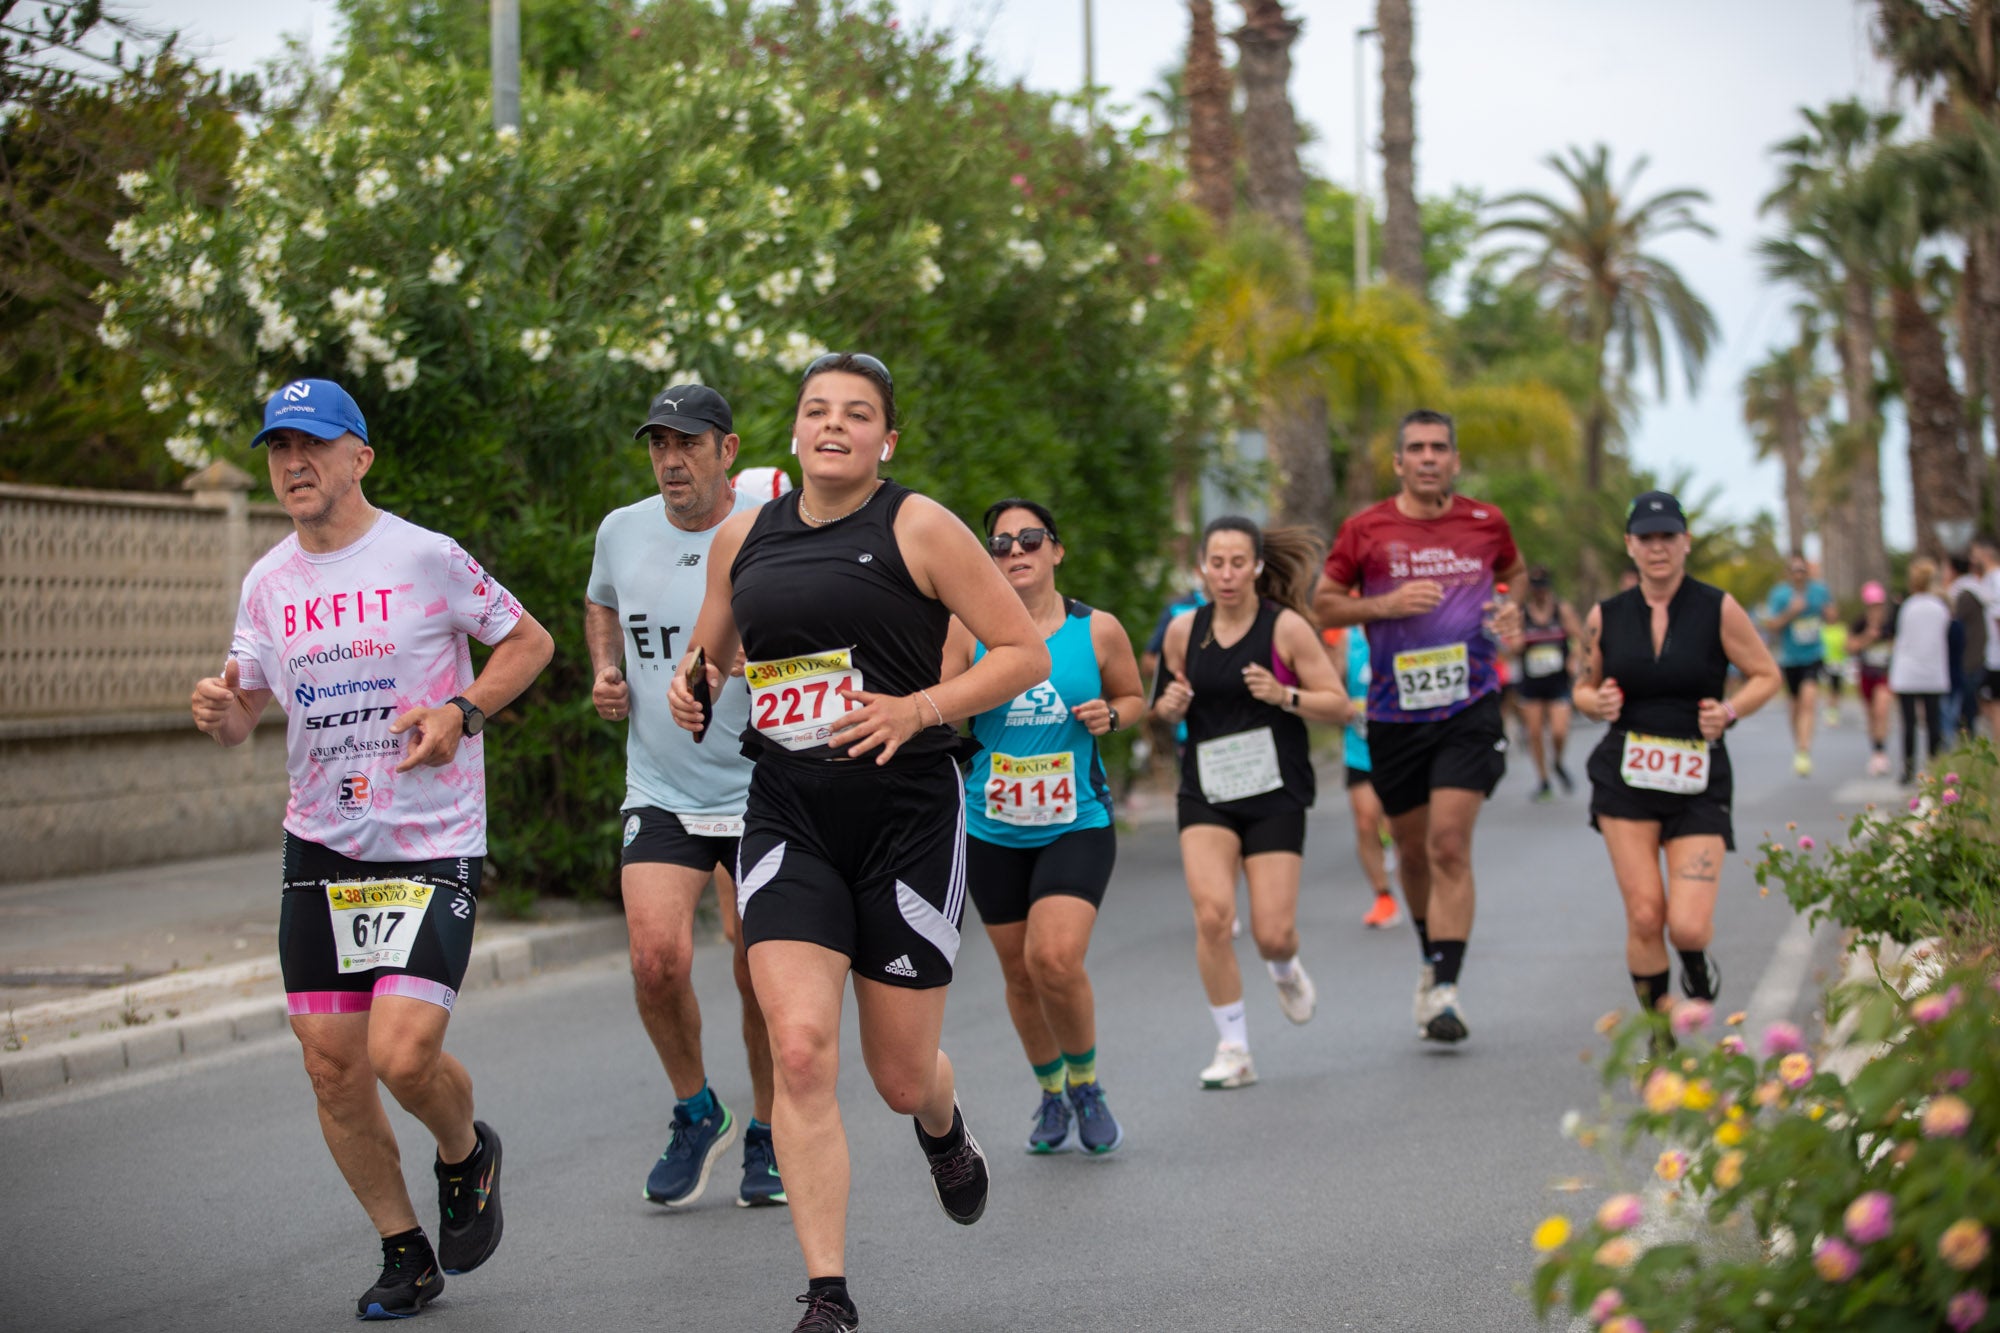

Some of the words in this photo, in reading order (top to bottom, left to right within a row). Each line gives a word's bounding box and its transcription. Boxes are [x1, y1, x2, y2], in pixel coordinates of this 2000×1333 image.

[274, 404, 317, 417] nutrinovex
[1410, 547, 1457, 563] MEDIA
[284, 589, 393, 637] BKFIT
[289, 638, 396, 676] nevadaBike
[757, 664, 779, 680] 38
[1400, 665, 1466, 694] 3252
[317, 677, 397, 699] nutrinovex
[756, 675, 854, 730] 2271
[306, 705, 398, 730] SCOTT
[351, 739, 400, 753] ASESOR
[1627, 747, 1704, 779] 2012
[988, 777, 1073, 807] 2114
[432, 877, 459, 888] mobel
[344, 888, 362, 904] 38
[352, 911, 406, 948] 617
[884, 965, 917, 978] adidas
